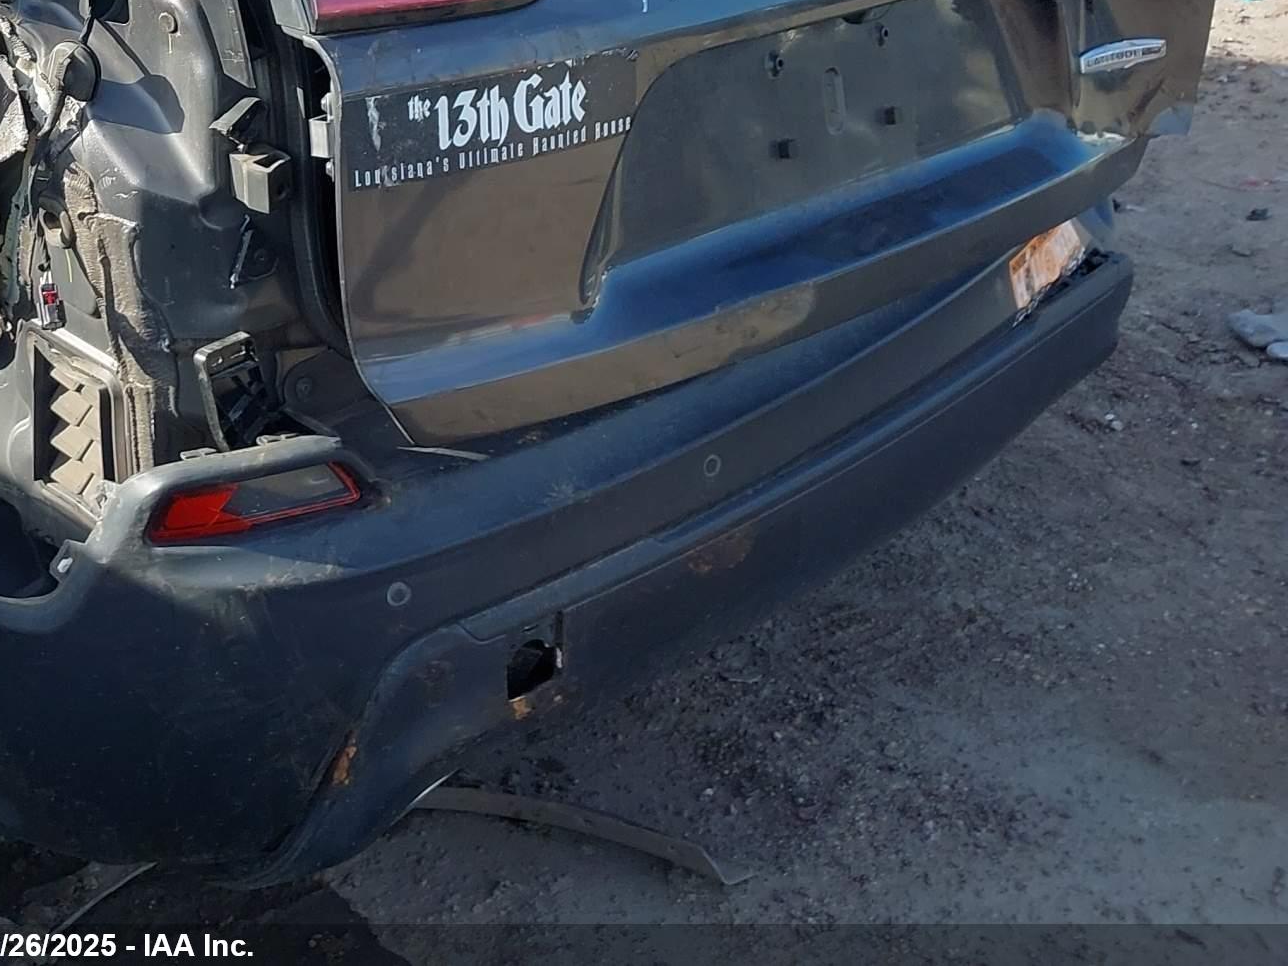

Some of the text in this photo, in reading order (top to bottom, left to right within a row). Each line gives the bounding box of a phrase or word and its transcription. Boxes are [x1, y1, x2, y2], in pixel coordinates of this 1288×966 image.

[408, 70, 587, 151] the 13th Gate
[458, 141, 524, 170] Ultimate
[532, 125, 587, 155] Haunted
[594, 115, 632, 141] House
